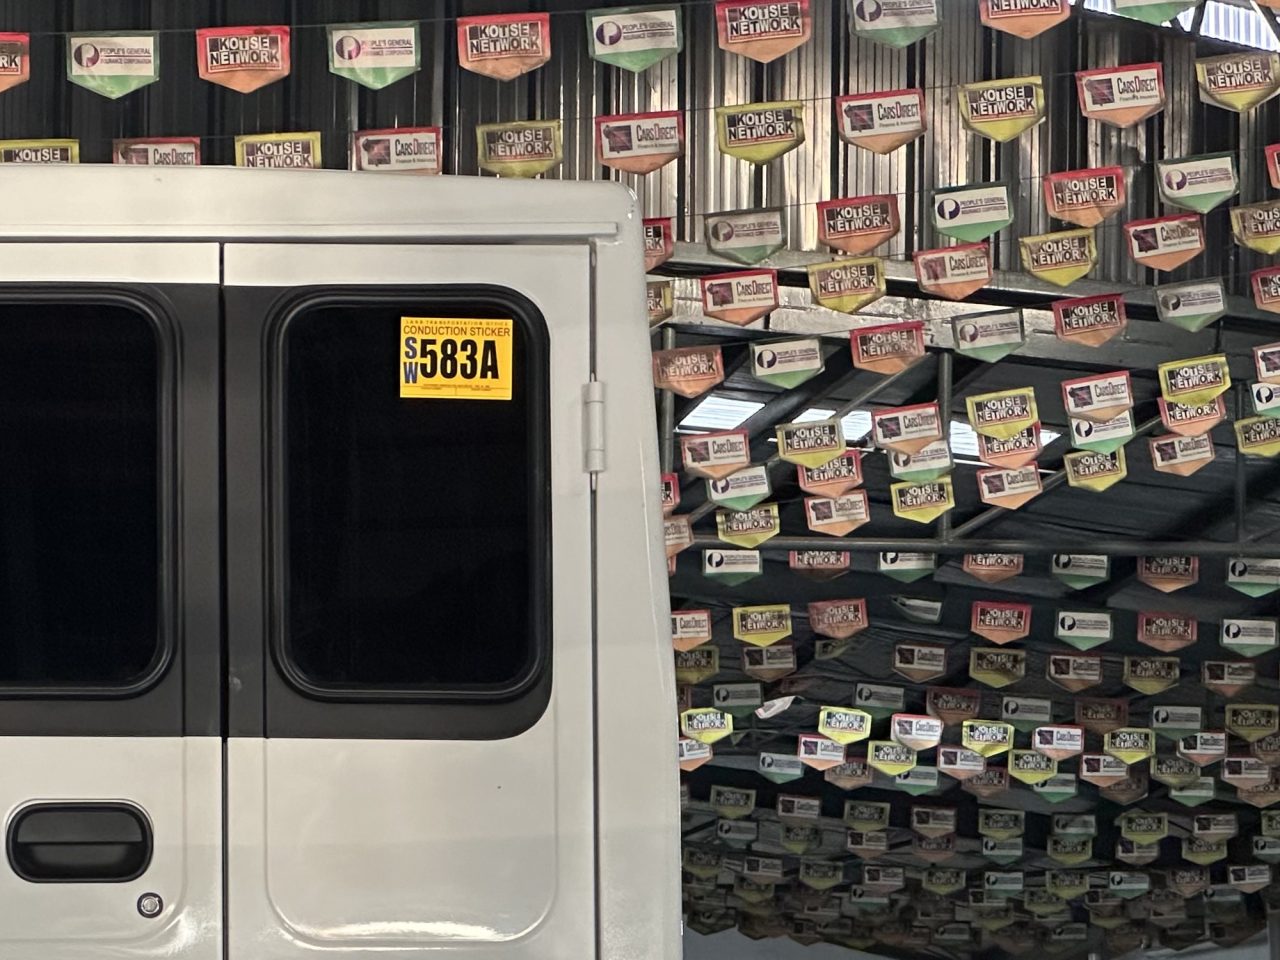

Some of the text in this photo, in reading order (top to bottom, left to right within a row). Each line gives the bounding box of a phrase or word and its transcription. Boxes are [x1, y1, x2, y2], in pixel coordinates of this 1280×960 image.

[739, 4, 789, 20] KOTSE
[480, 22, 530, 37] KOTSE
[730, 16, 800, 35] NETWORK
[220, 36, 269, 50] KOTSE
[469, 37, 538, 53] NETWORK
[210, 50, 279, 64] NETWORK
[1216, 61, 1260, 73] KOTSE
[1208, 71, 1271, 88] NETWORK
[978, 87, 1024, 101] KOTSE
[971, 98, 1035, 115] NETWORK
[737, 111, 784, 126] KOTSE
[498, 130, 542, 143] KOTSE
[728, 122, 794, 141] NETWORK
[13, 150, 59, 161] KOTSE
[255, 142, 300, 156] KOTSE
[488, 142, 553, 155] NETWORK
[246, 154, 311, 168] NETWORK
[835, 204, 880, 219] KOTSE
[827, 217, 890, 232] NETWORK
[1039, 238, 1078, 252] KOTSE
[1031, 249, 1087, 266] NETWORK
[1071, 304, 1108, 317] KOTSE
[1064, 313, 1118, 328] NETWORK
[404, 326, 510, 336] CONDUCTION STICKER
[420, 338, 499, 379] 583A
[792, 427, 829, 439] KOTSE
[786, 436, 836, 449] NETWORK
